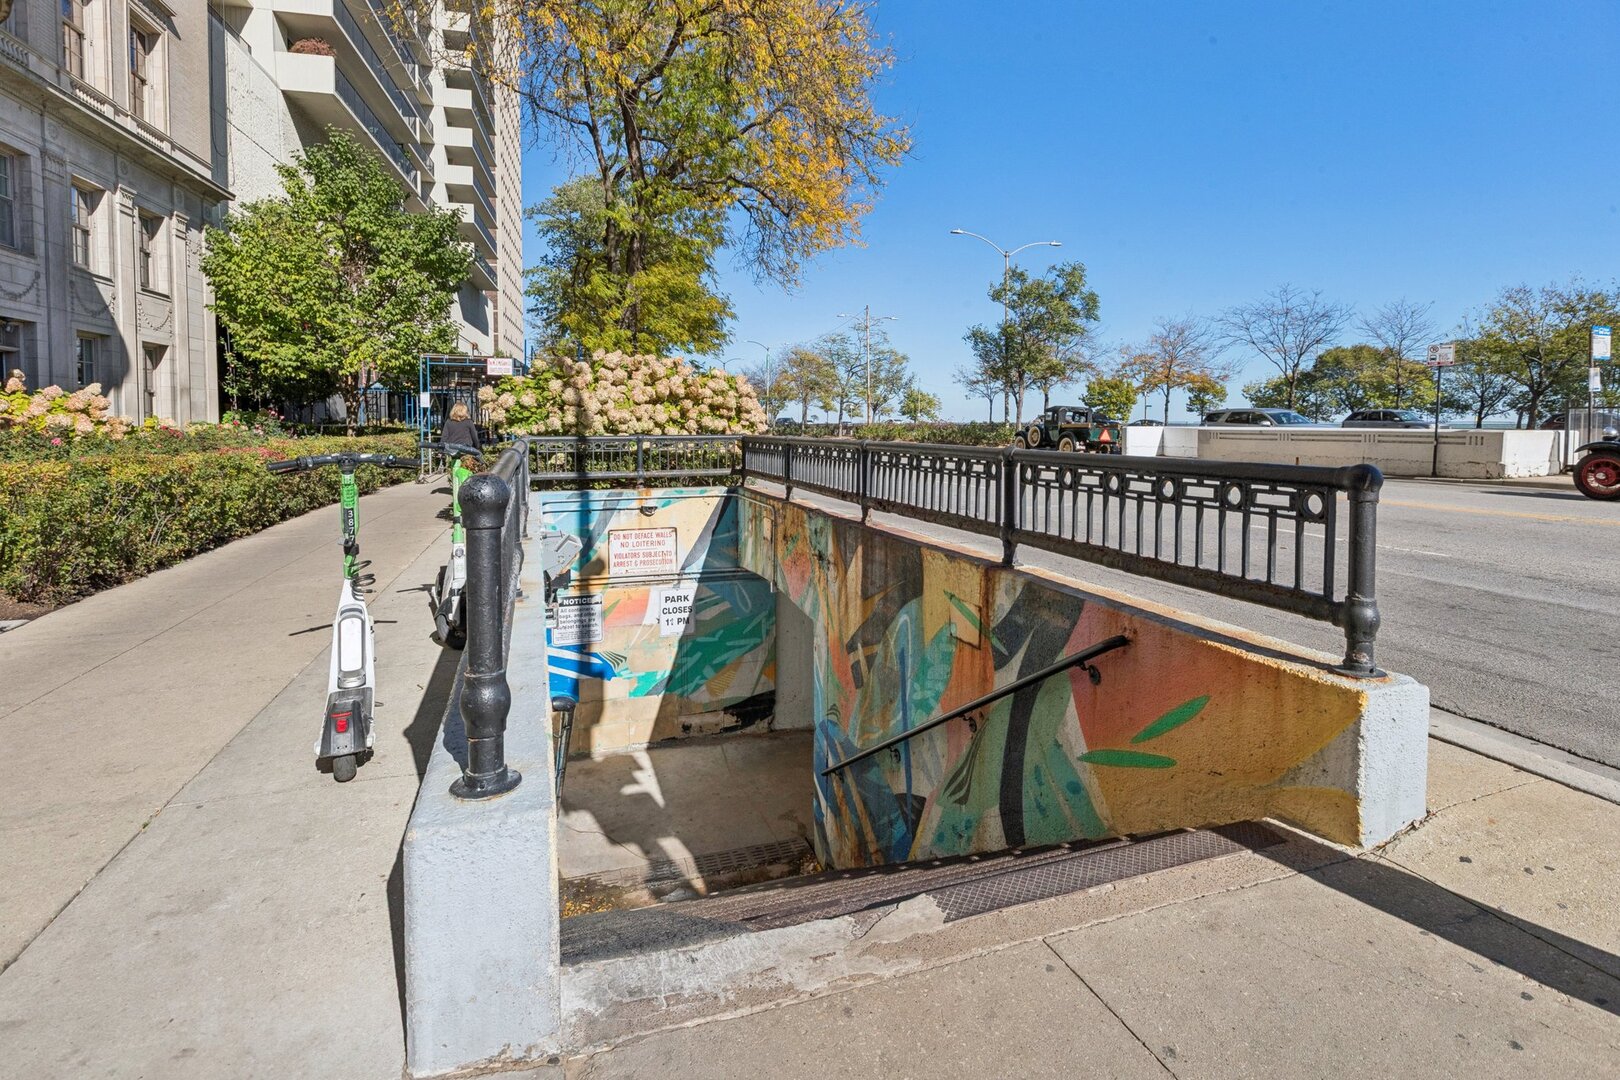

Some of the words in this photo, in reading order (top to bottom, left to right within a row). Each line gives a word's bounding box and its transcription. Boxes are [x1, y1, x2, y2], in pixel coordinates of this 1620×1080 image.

[563, 598, 592, 606] NOTICE
[664, 594, 690, 603] PARK
[662, 606, 692, 614] CLOSES
[677, 616, 690, 624] PM
